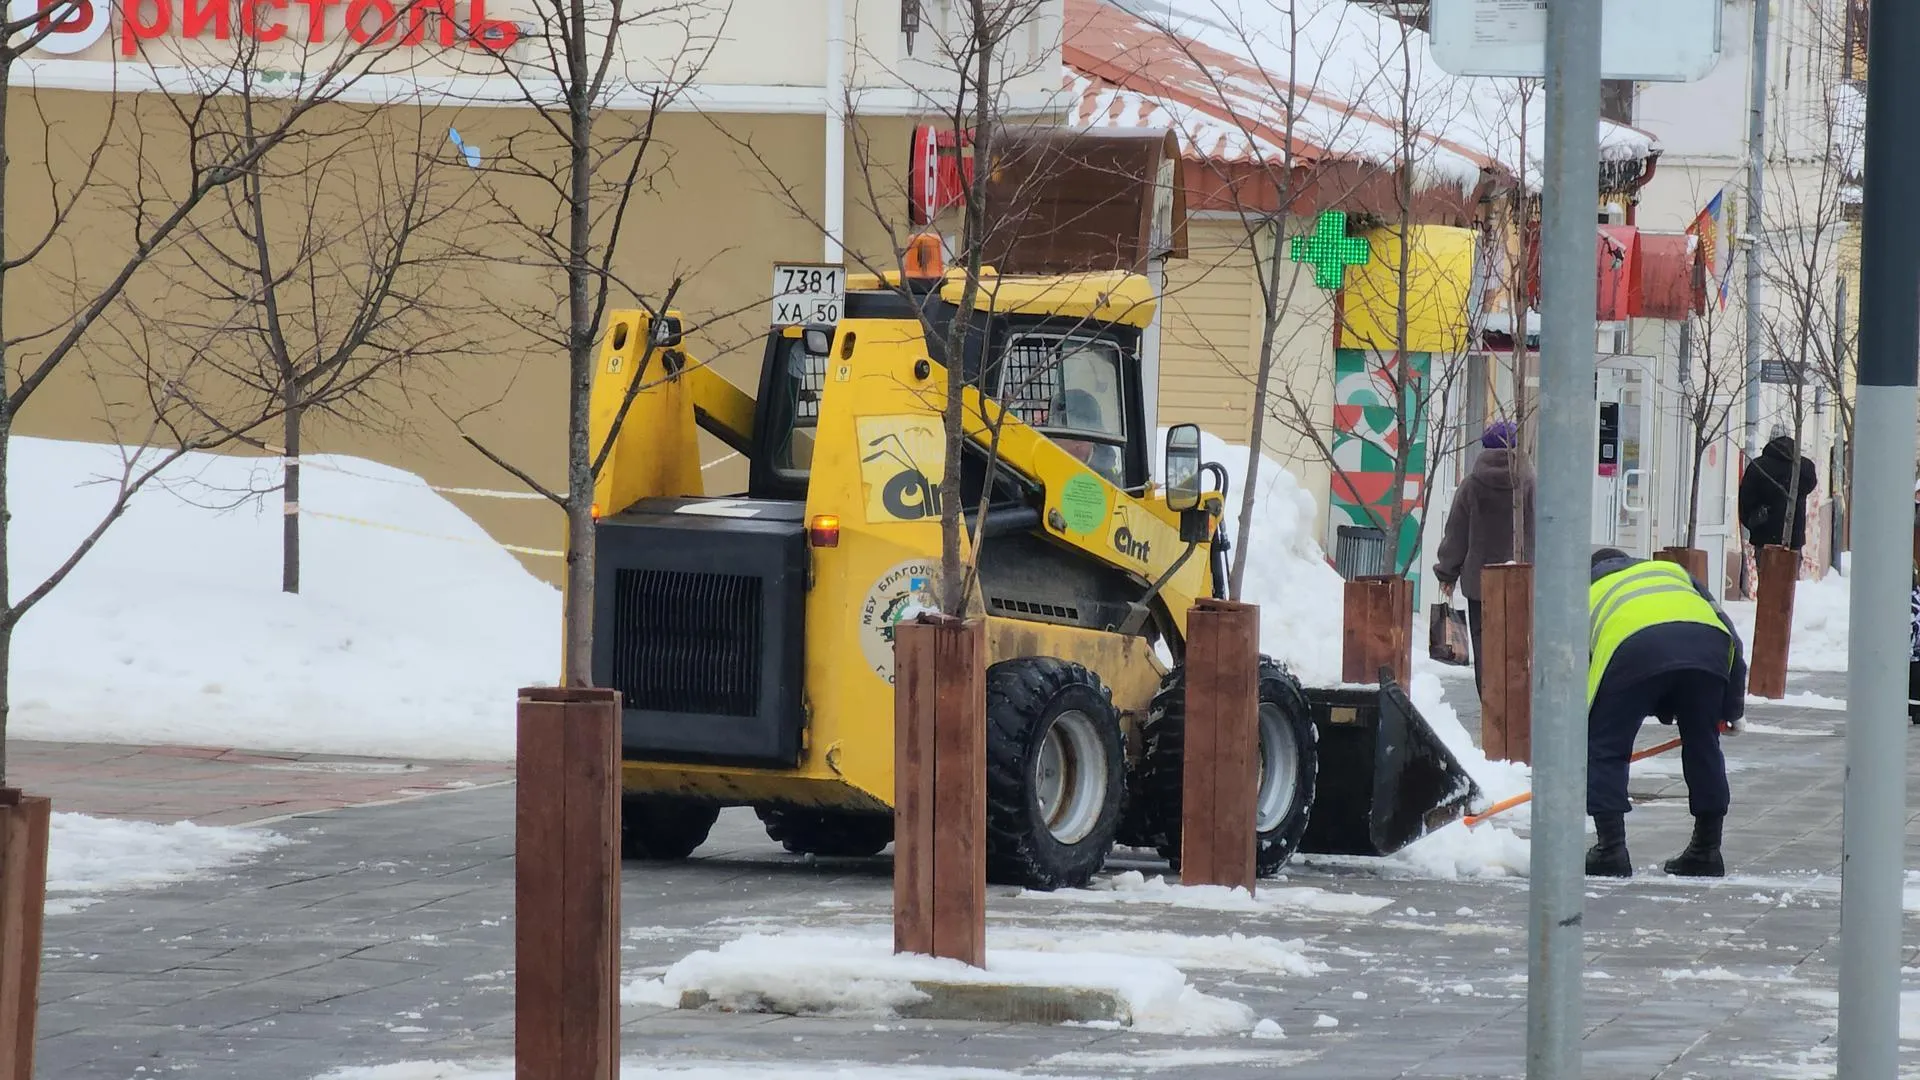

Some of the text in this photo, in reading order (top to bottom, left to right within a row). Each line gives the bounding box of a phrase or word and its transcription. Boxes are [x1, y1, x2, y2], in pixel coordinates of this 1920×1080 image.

[782, 269, 836, 294] 7381
[777, 303, 838, 322] ХА 50
